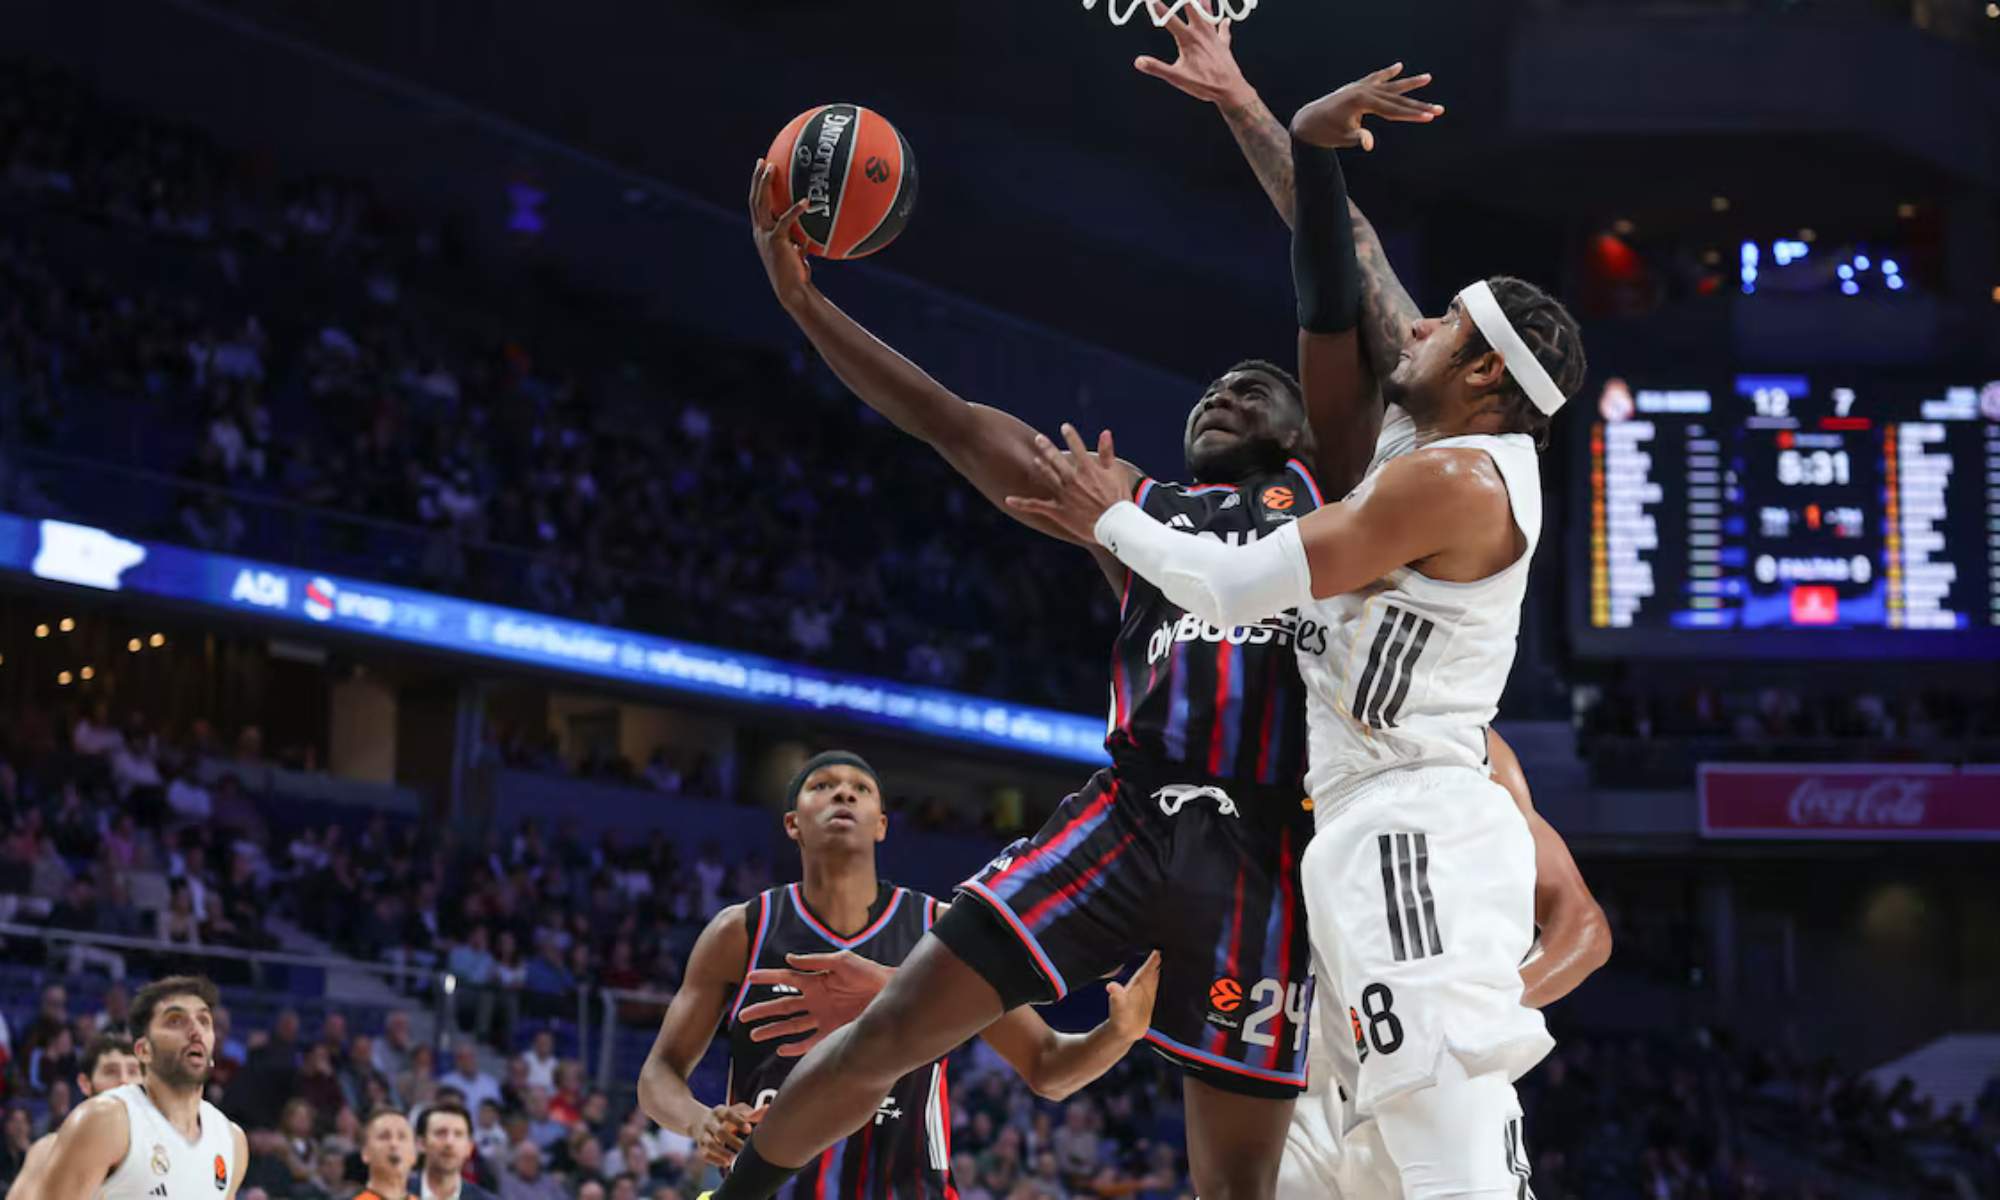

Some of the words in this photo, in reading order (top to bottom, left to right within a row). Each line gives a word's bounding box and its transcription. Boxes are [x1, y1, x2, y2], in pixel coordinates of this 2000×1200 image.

[806, 112, 854, 217] SPALDING
[1753, 386, 1790, 417] 12
[1832, 387, 1856, 417] 7
[1241, 977, 1307, 1051] 24
[1362, 983, 1404, 1055] 8
